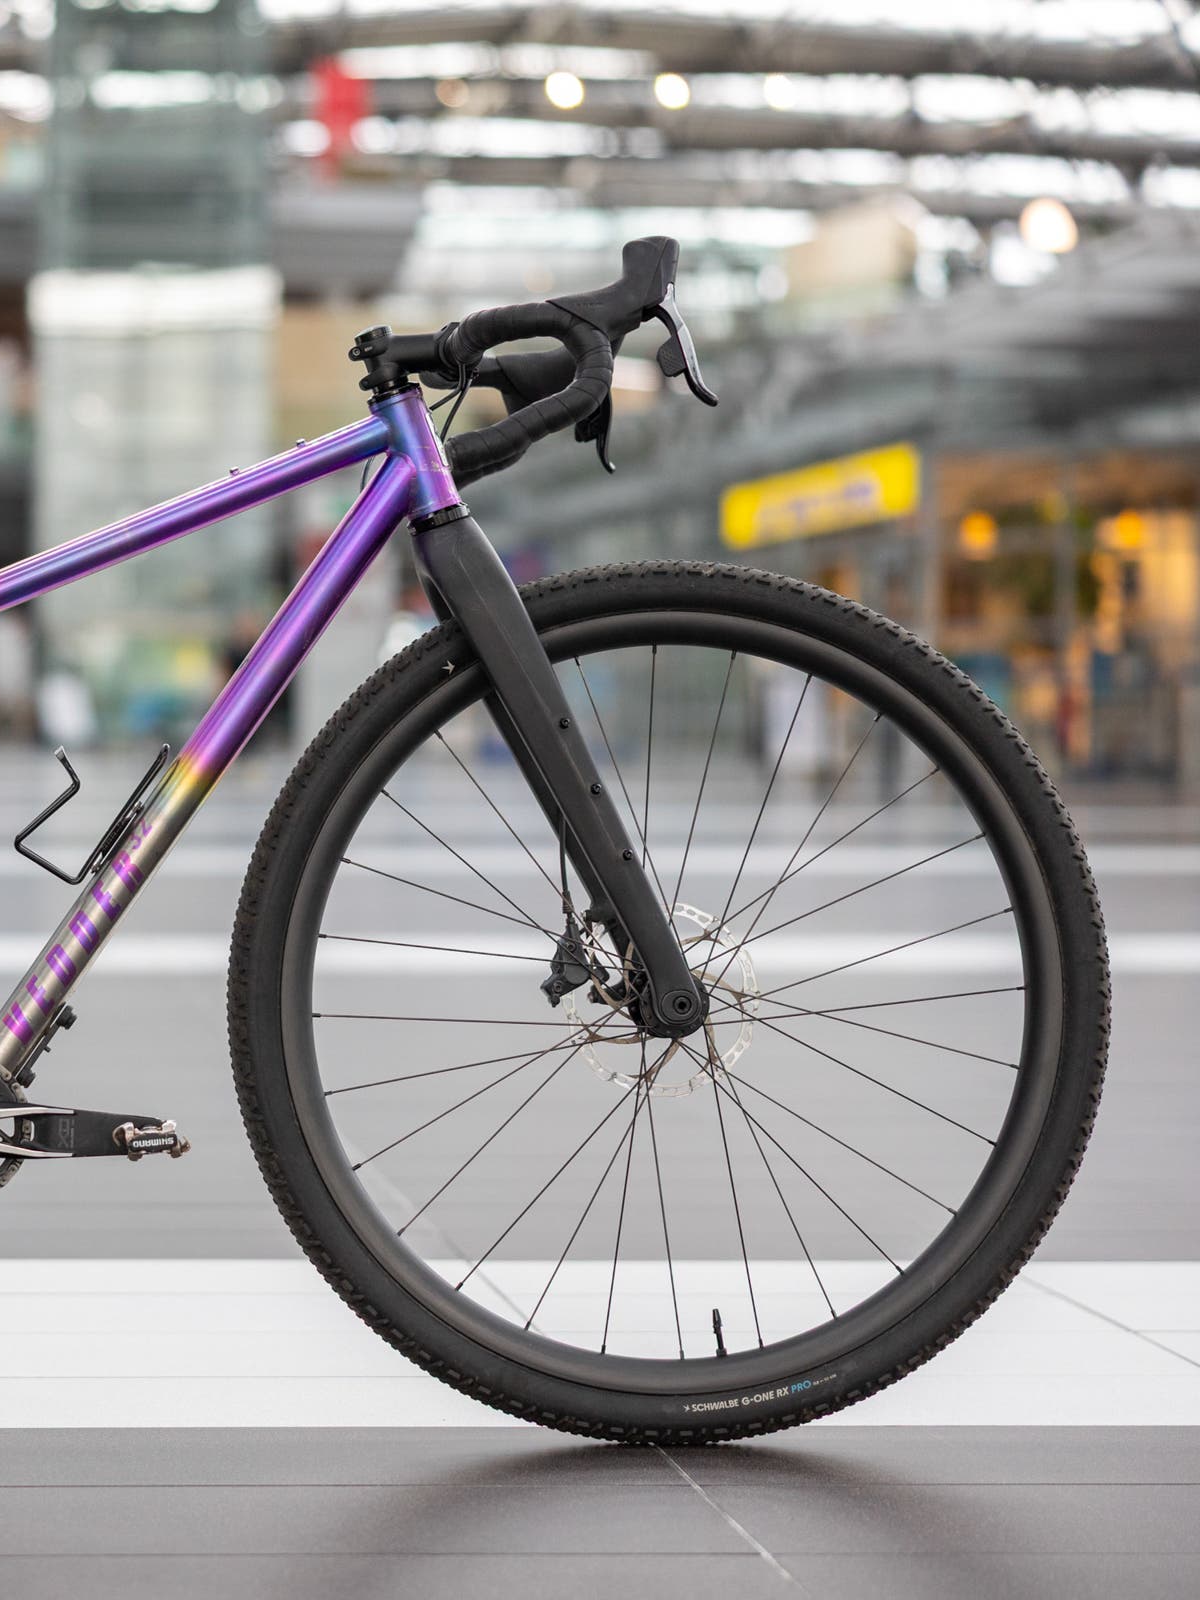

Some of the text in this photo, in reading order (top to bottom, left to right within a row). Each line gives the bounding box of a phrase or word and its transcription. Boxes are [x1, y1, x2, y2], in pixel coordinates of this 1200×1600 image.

[2, 817, 153, 1045] VEDDER 32
[132, 1135, 175, 1148] SHIMANO
[691, 1380, 812, 1412] SCHWALBE G-ONE RX PRO
